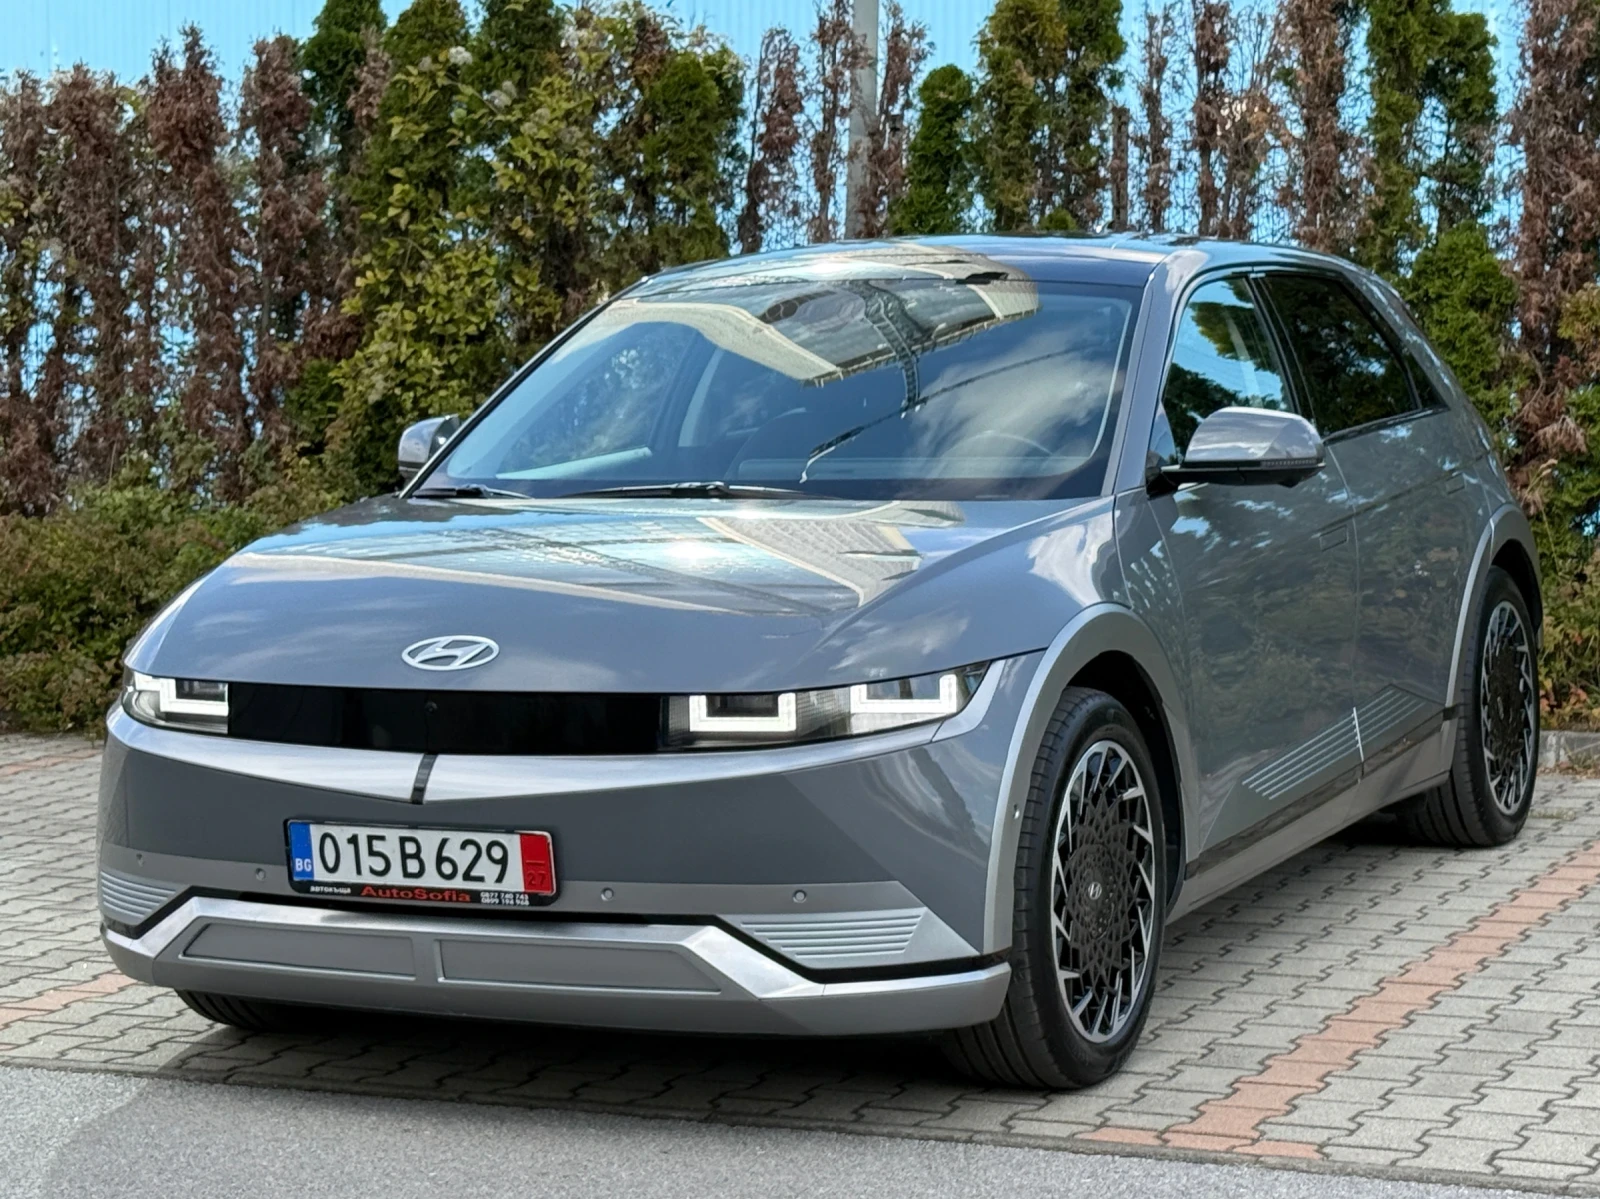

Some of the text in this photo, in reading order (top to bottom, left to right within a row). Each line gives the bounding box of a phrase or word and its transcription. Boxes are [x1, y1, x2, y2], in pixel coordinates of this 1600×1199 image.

[295, 858, 312, 872] BG
[527, 871, 547, 887] 27
[361, 885, 471, 902] AutoSofia
